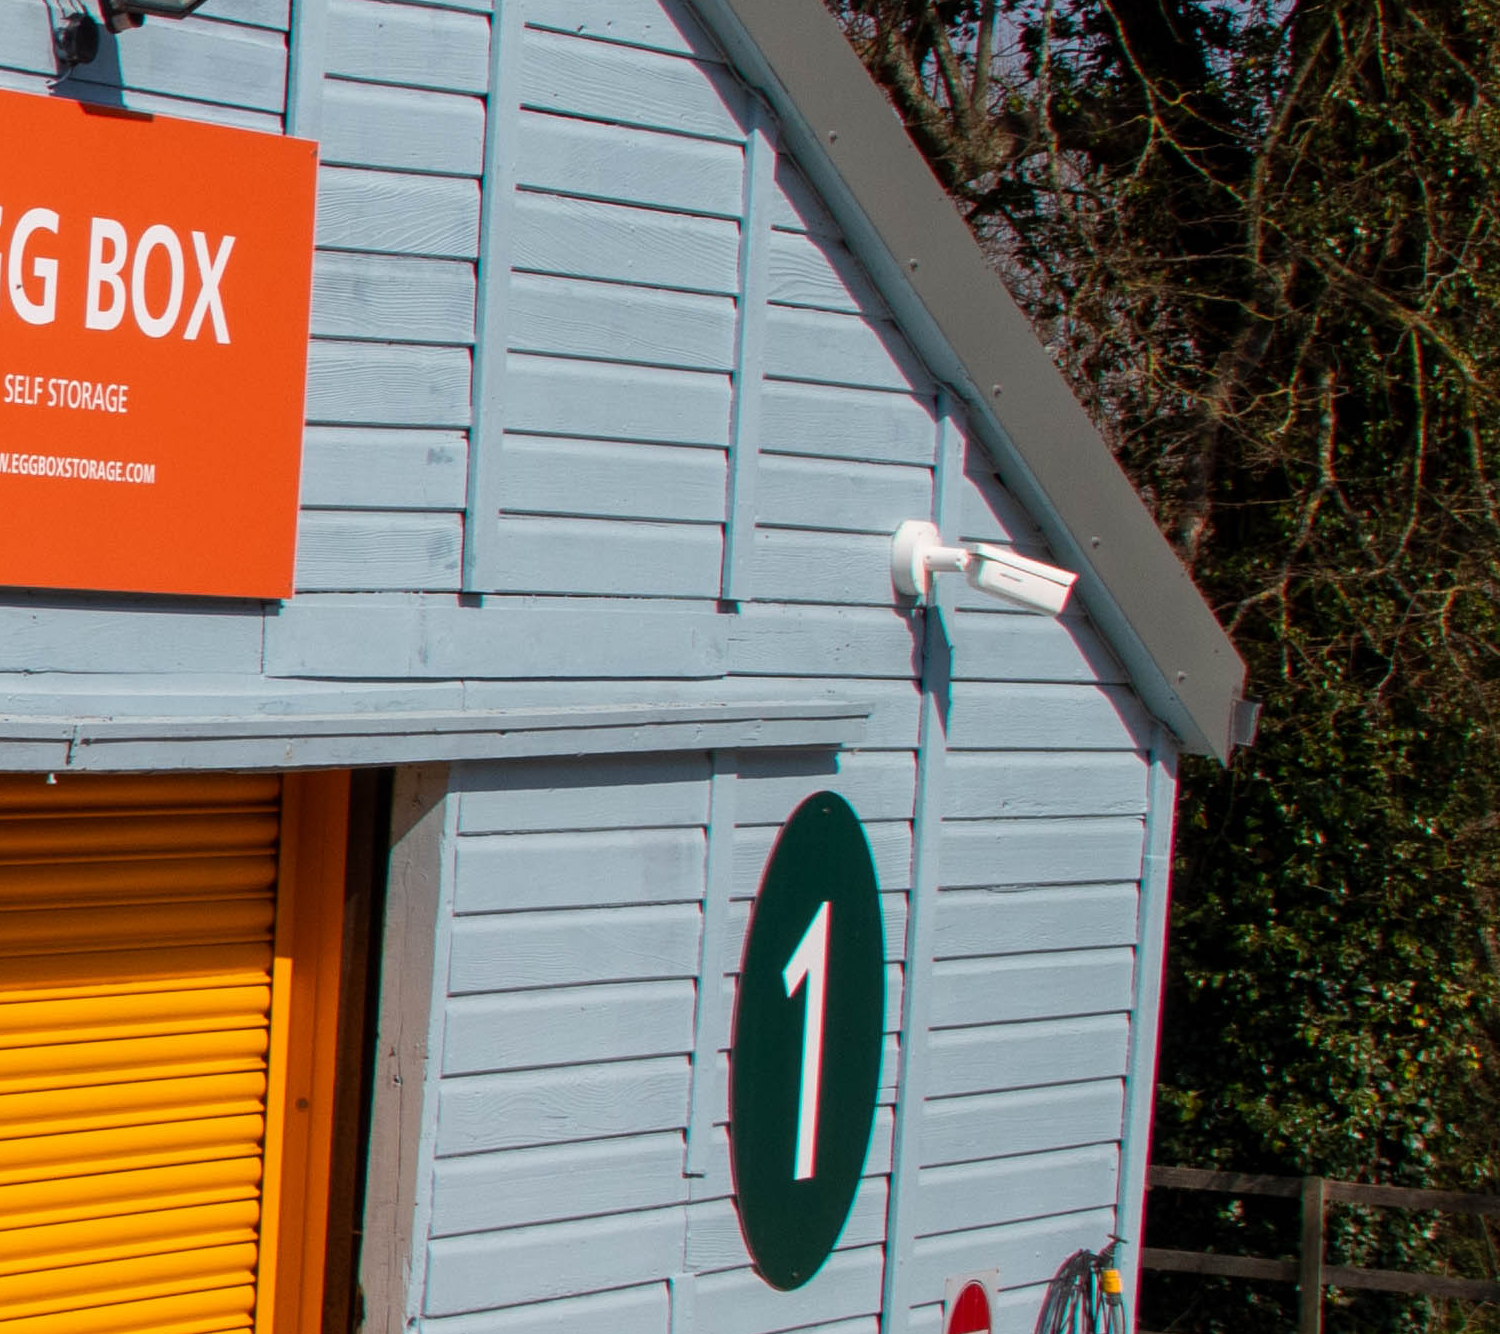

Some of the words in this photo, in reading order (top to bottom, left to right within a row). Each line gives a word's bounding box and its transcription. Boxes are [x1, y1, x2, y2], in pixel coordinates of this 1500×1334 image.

[85, 217, 236, 344] BOX
[3, 373, 44, 405] SELF
[47, 378, 129, 413] STORAGE
[781, 901, 830, 1181] 1
